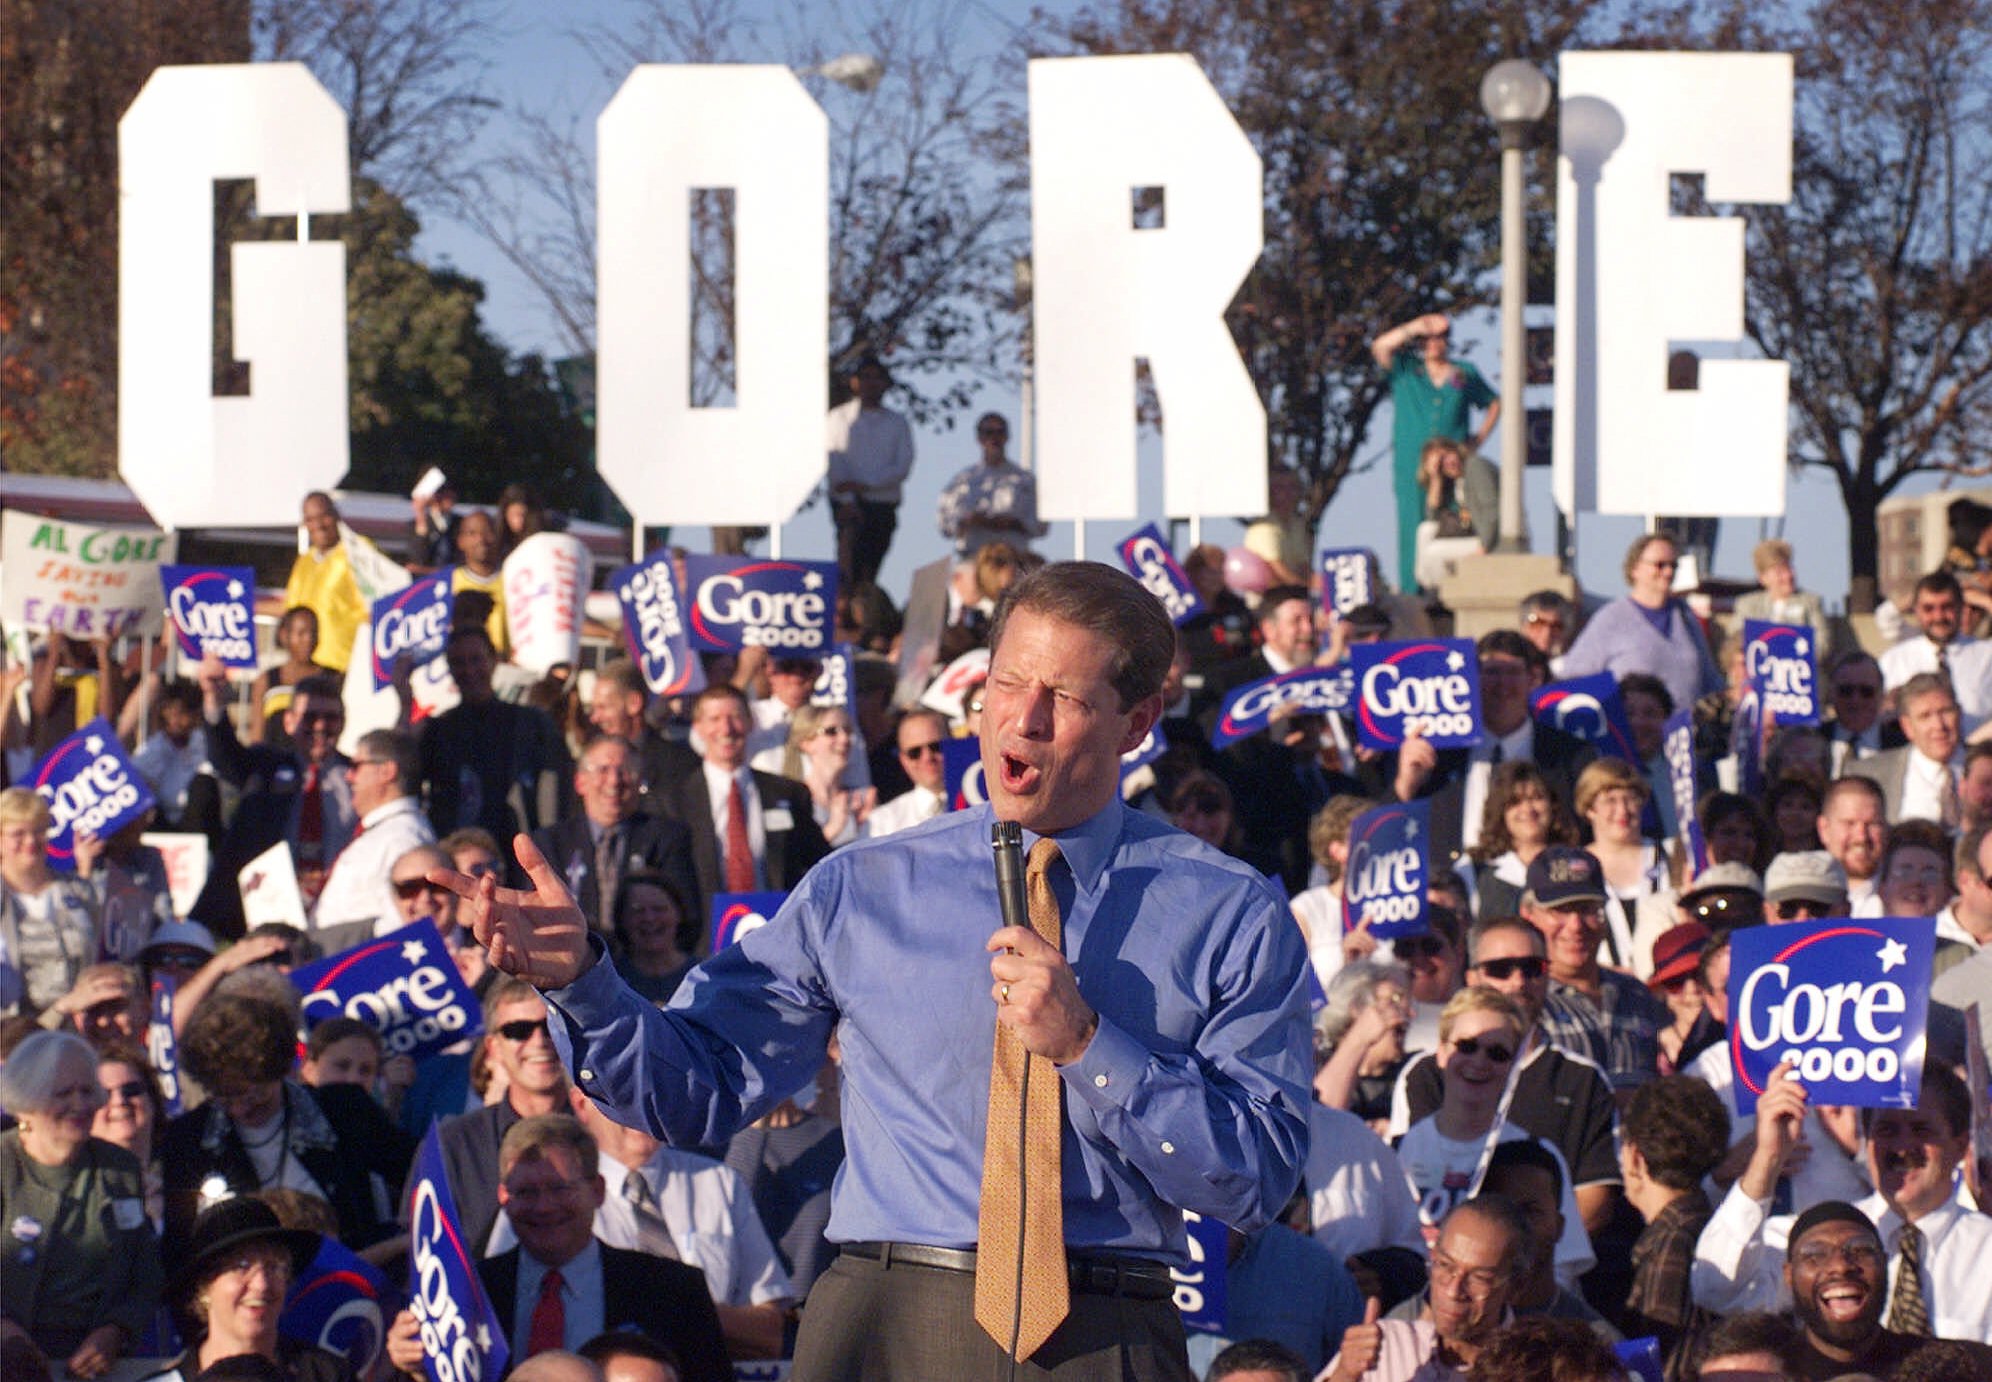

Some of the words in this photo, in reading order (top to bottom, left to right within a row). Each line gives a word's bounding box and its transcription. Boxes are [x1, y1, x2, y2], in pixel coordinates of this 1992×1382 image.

[117, 51, 1793, 529] GORE
[30, 523, 69, 553] AL
[80, 530, 165, 563] GORE
[24, 598, 147, 634] EARTH
[170, 586, 249, 639] Gore
[697, 574, 825, 628] Gore
[375, 601, 447, 659] Gore
[631, 568, 675, 694] Gore
[742, 626, 823, 648] 2000
[1362, 664, 1471, 717] Gore
[1403, 713, 1473, 737] 2000
[1347, 841, 1420, 904] Gore
[381, 1004, 467, 1056] 000
[1738, 963, 1906, 1051] Gore
[1780, 1047, 1898, 1082] 2000
[412, 1178, 481, 1382] Gore
